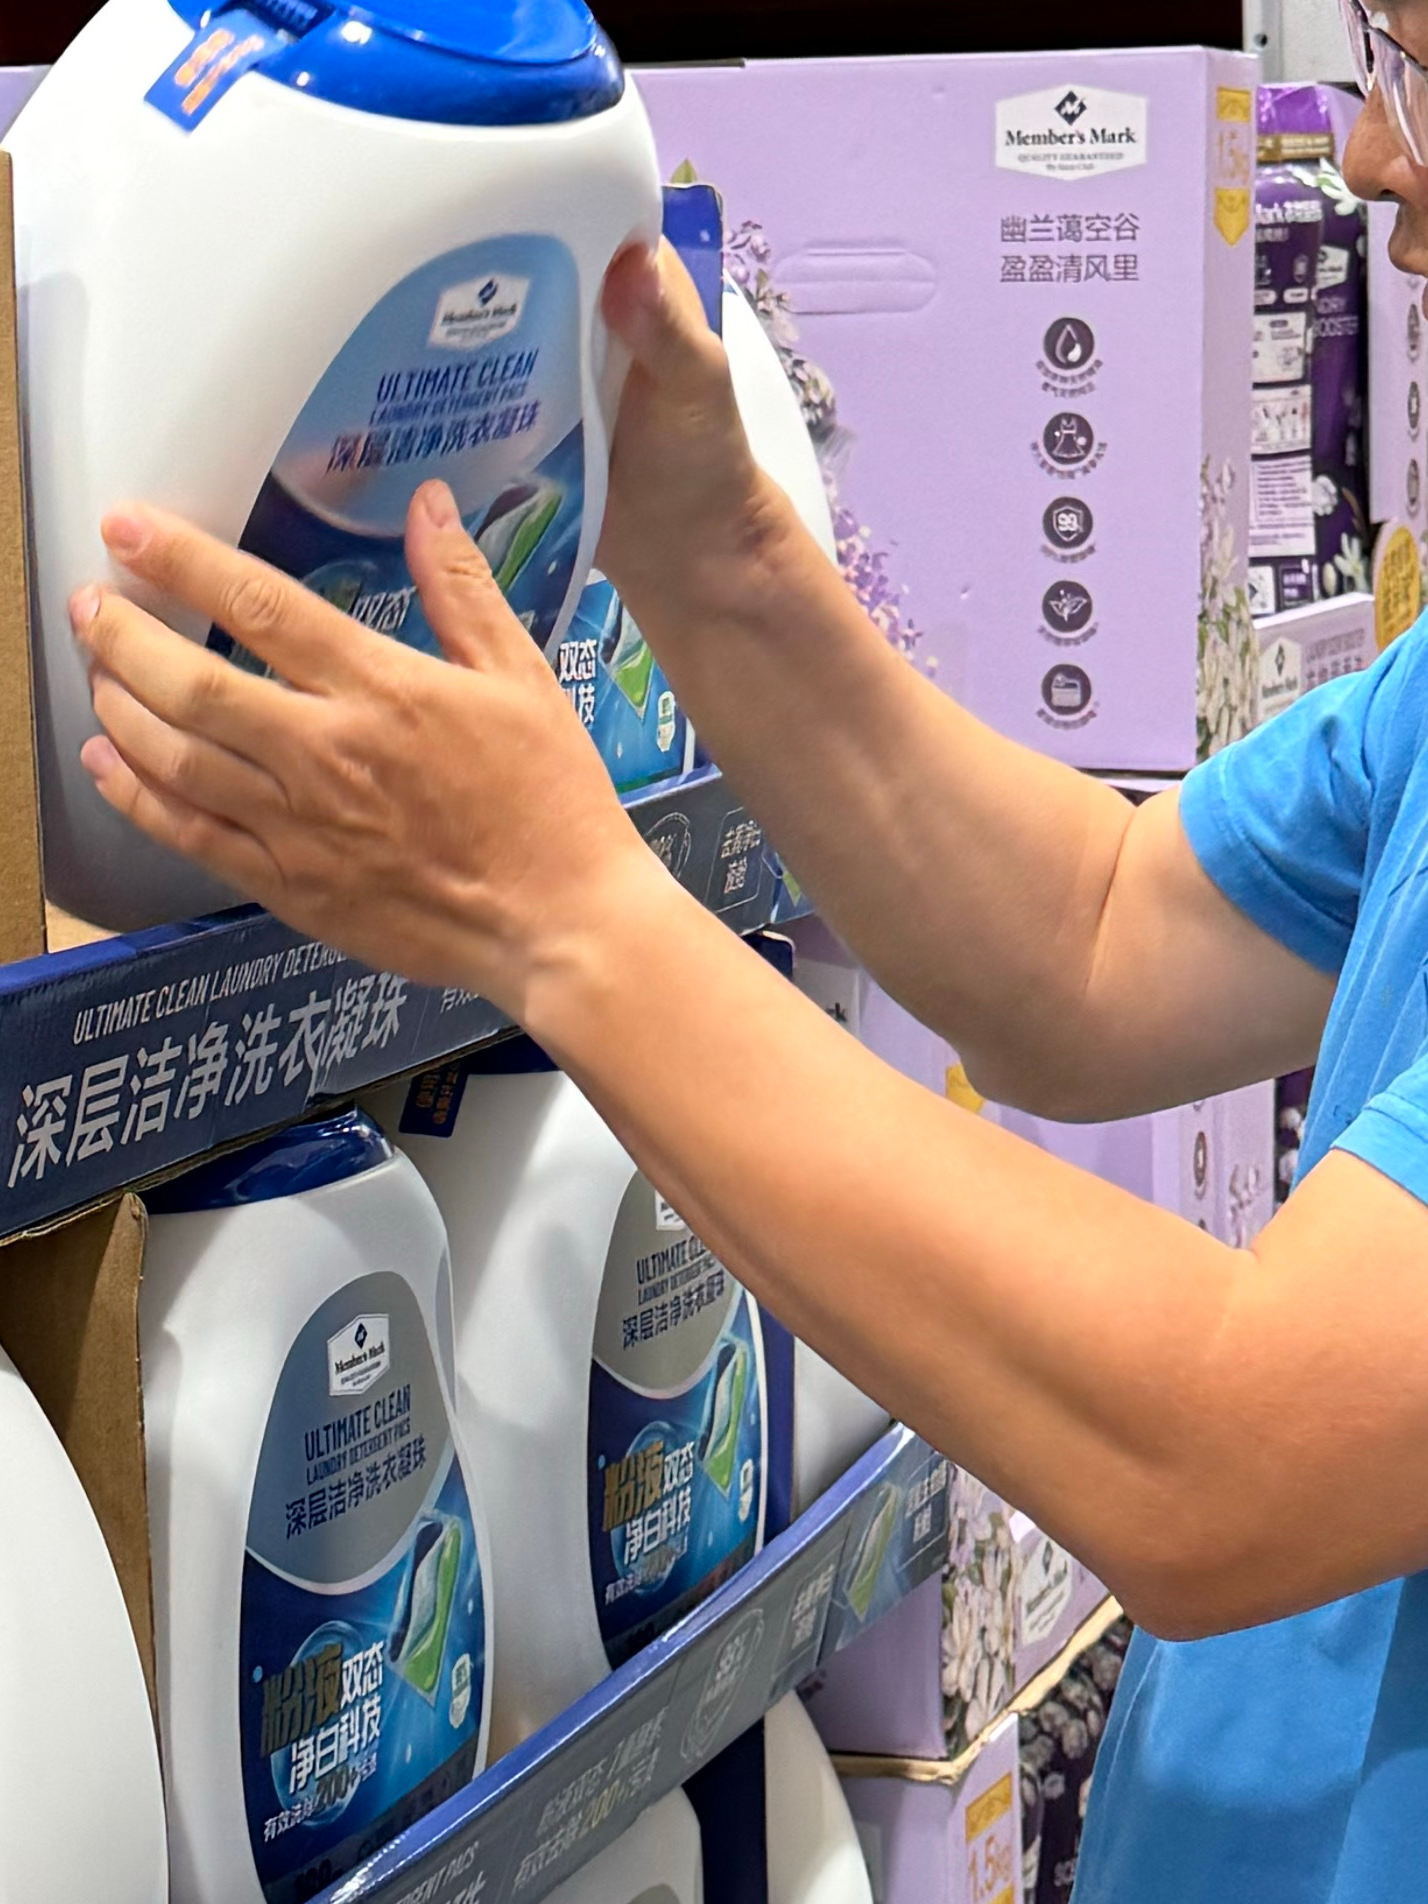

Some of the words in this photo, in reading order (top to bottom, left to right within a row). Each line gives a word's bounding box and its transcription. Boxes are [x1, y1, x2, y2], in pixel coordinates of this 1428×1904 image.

[1004, 127, 1084, 148] Member's
[1088, 125, 1137, 145] Mark
[999, 253, 1140, 285] 盈盈清风里
[376, 362, 475, 404] ULTIMATE
[477, 347, 540, 389] CLEAN
[72, 998, 153, 1047] ULTIMATE
[155, 977, 209, 1017] CLEAN
[210, 951, 282, 1002] LAUNDRY
[6, 968, 410, 1190] 深层洁净洗衣凝珠
[304, 1405, 372, 1462] ULTIMATE
[374, 1383, 411, 1429] CLEAN
[286, 1432, 427, 1541] 深层洁净洗衣凝珠
